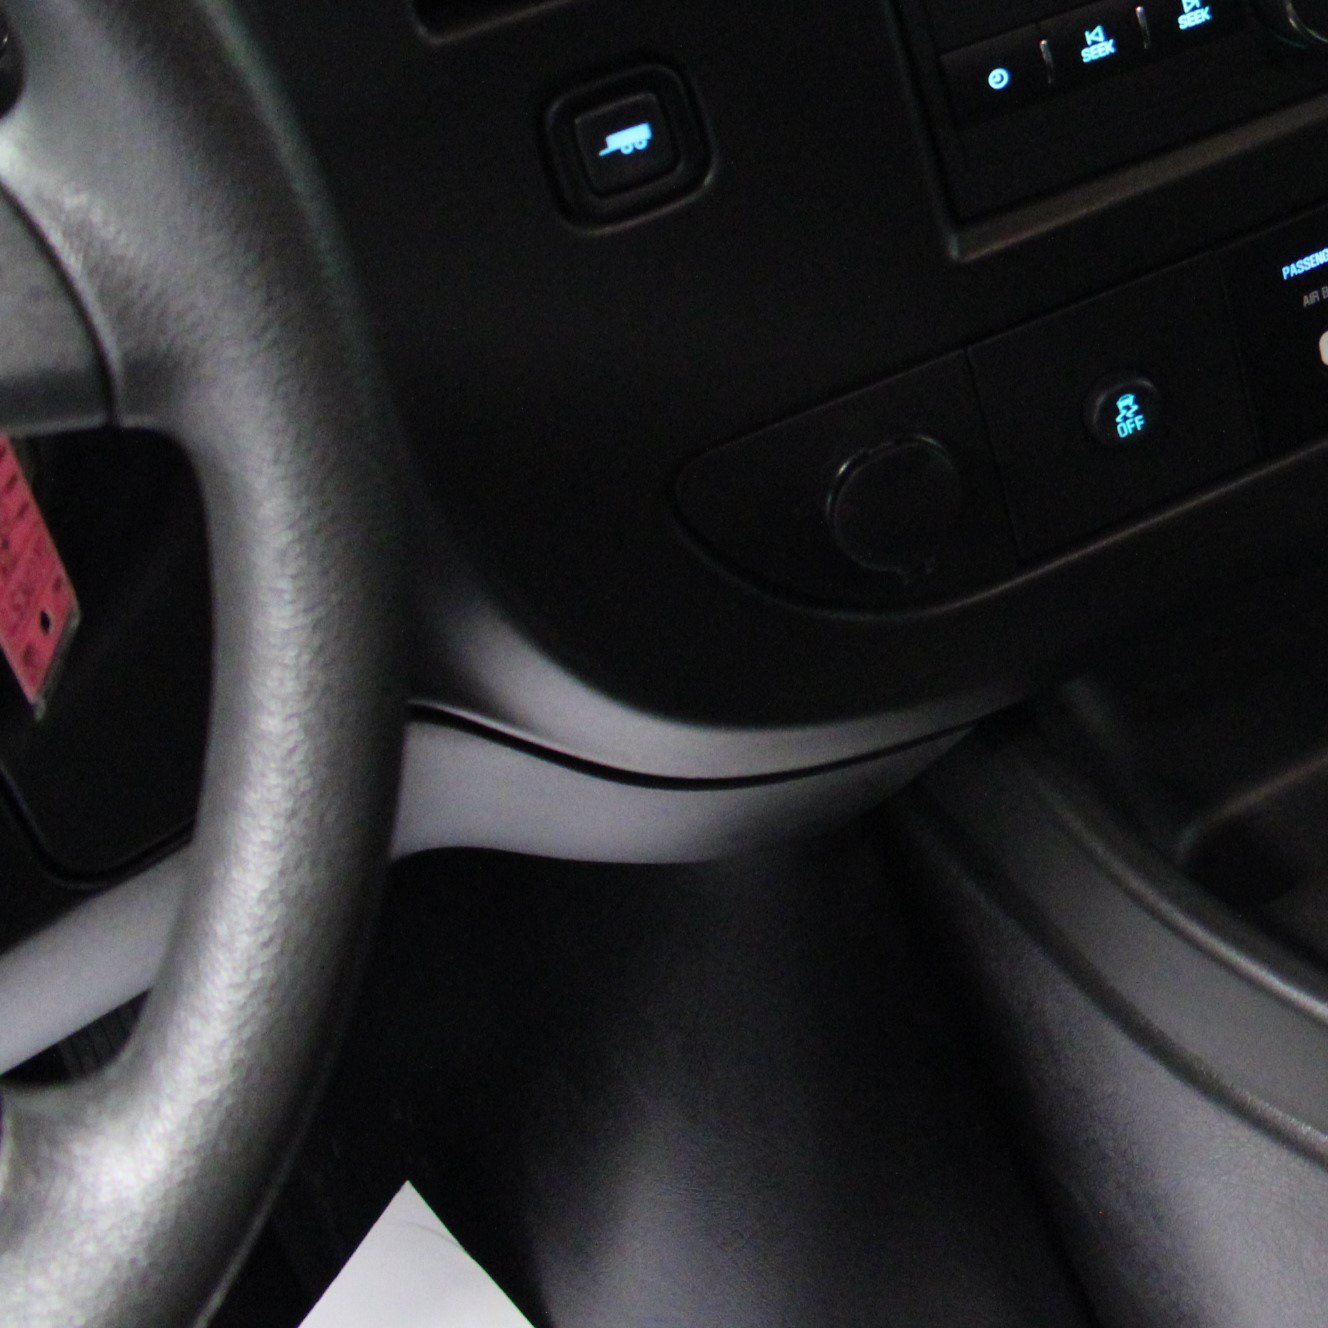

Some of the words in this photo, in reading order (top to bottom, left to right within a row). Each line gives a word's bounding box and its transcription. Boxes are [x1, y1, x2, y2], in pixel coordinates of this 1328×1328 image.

[1178, 6, 1211, 30] SEEK
[1080, 39, 1116, 63] SEEK
[1303, 290, 1320, 307] AIR
[1117, 414, 1144, 438] OFF
